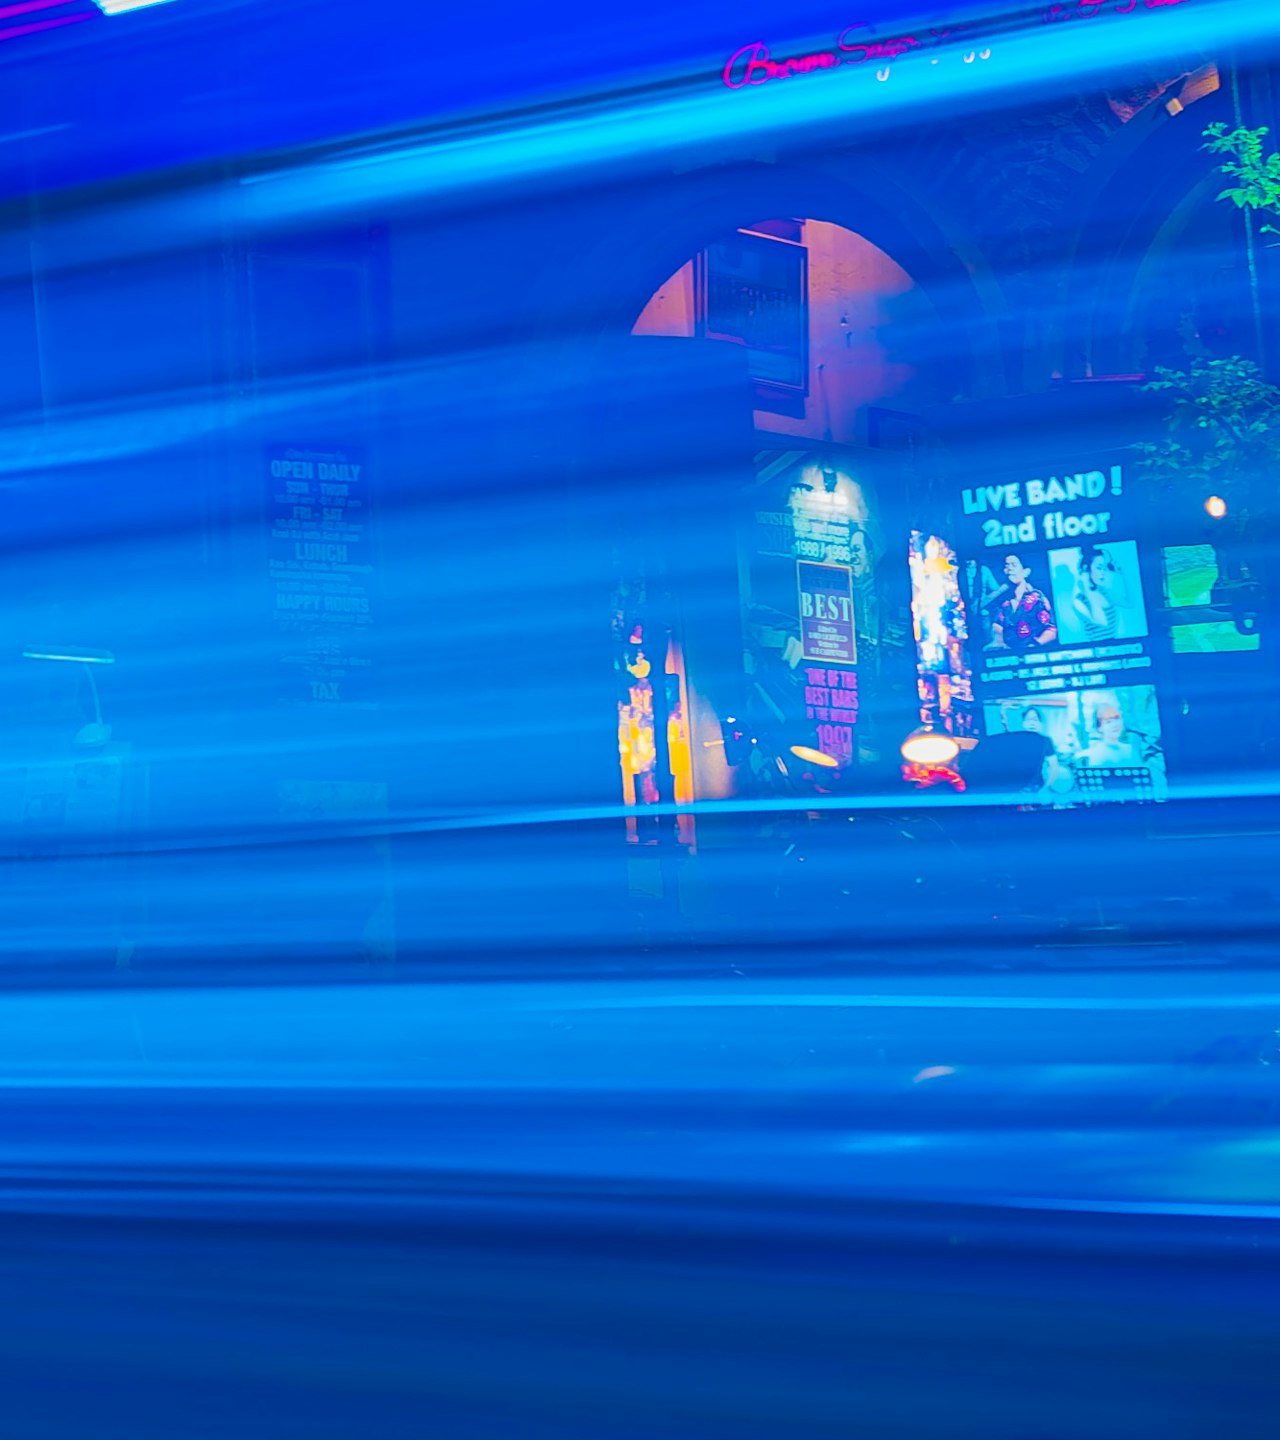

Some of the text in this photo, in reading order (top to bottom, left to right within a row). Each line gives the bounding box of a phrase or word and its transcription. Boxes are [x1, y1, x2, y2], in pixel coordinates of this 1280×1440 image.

[271, 460, 361, 482] OPEN DAILY
[962, 482, 1022, 514] LIVE
[982, 511, 1111, 547] 2nd floor
[296, 543, 348, 561] LUNCH
[801, 592, 851, 622] BEST
[309, 681, 340, 700] TAX
